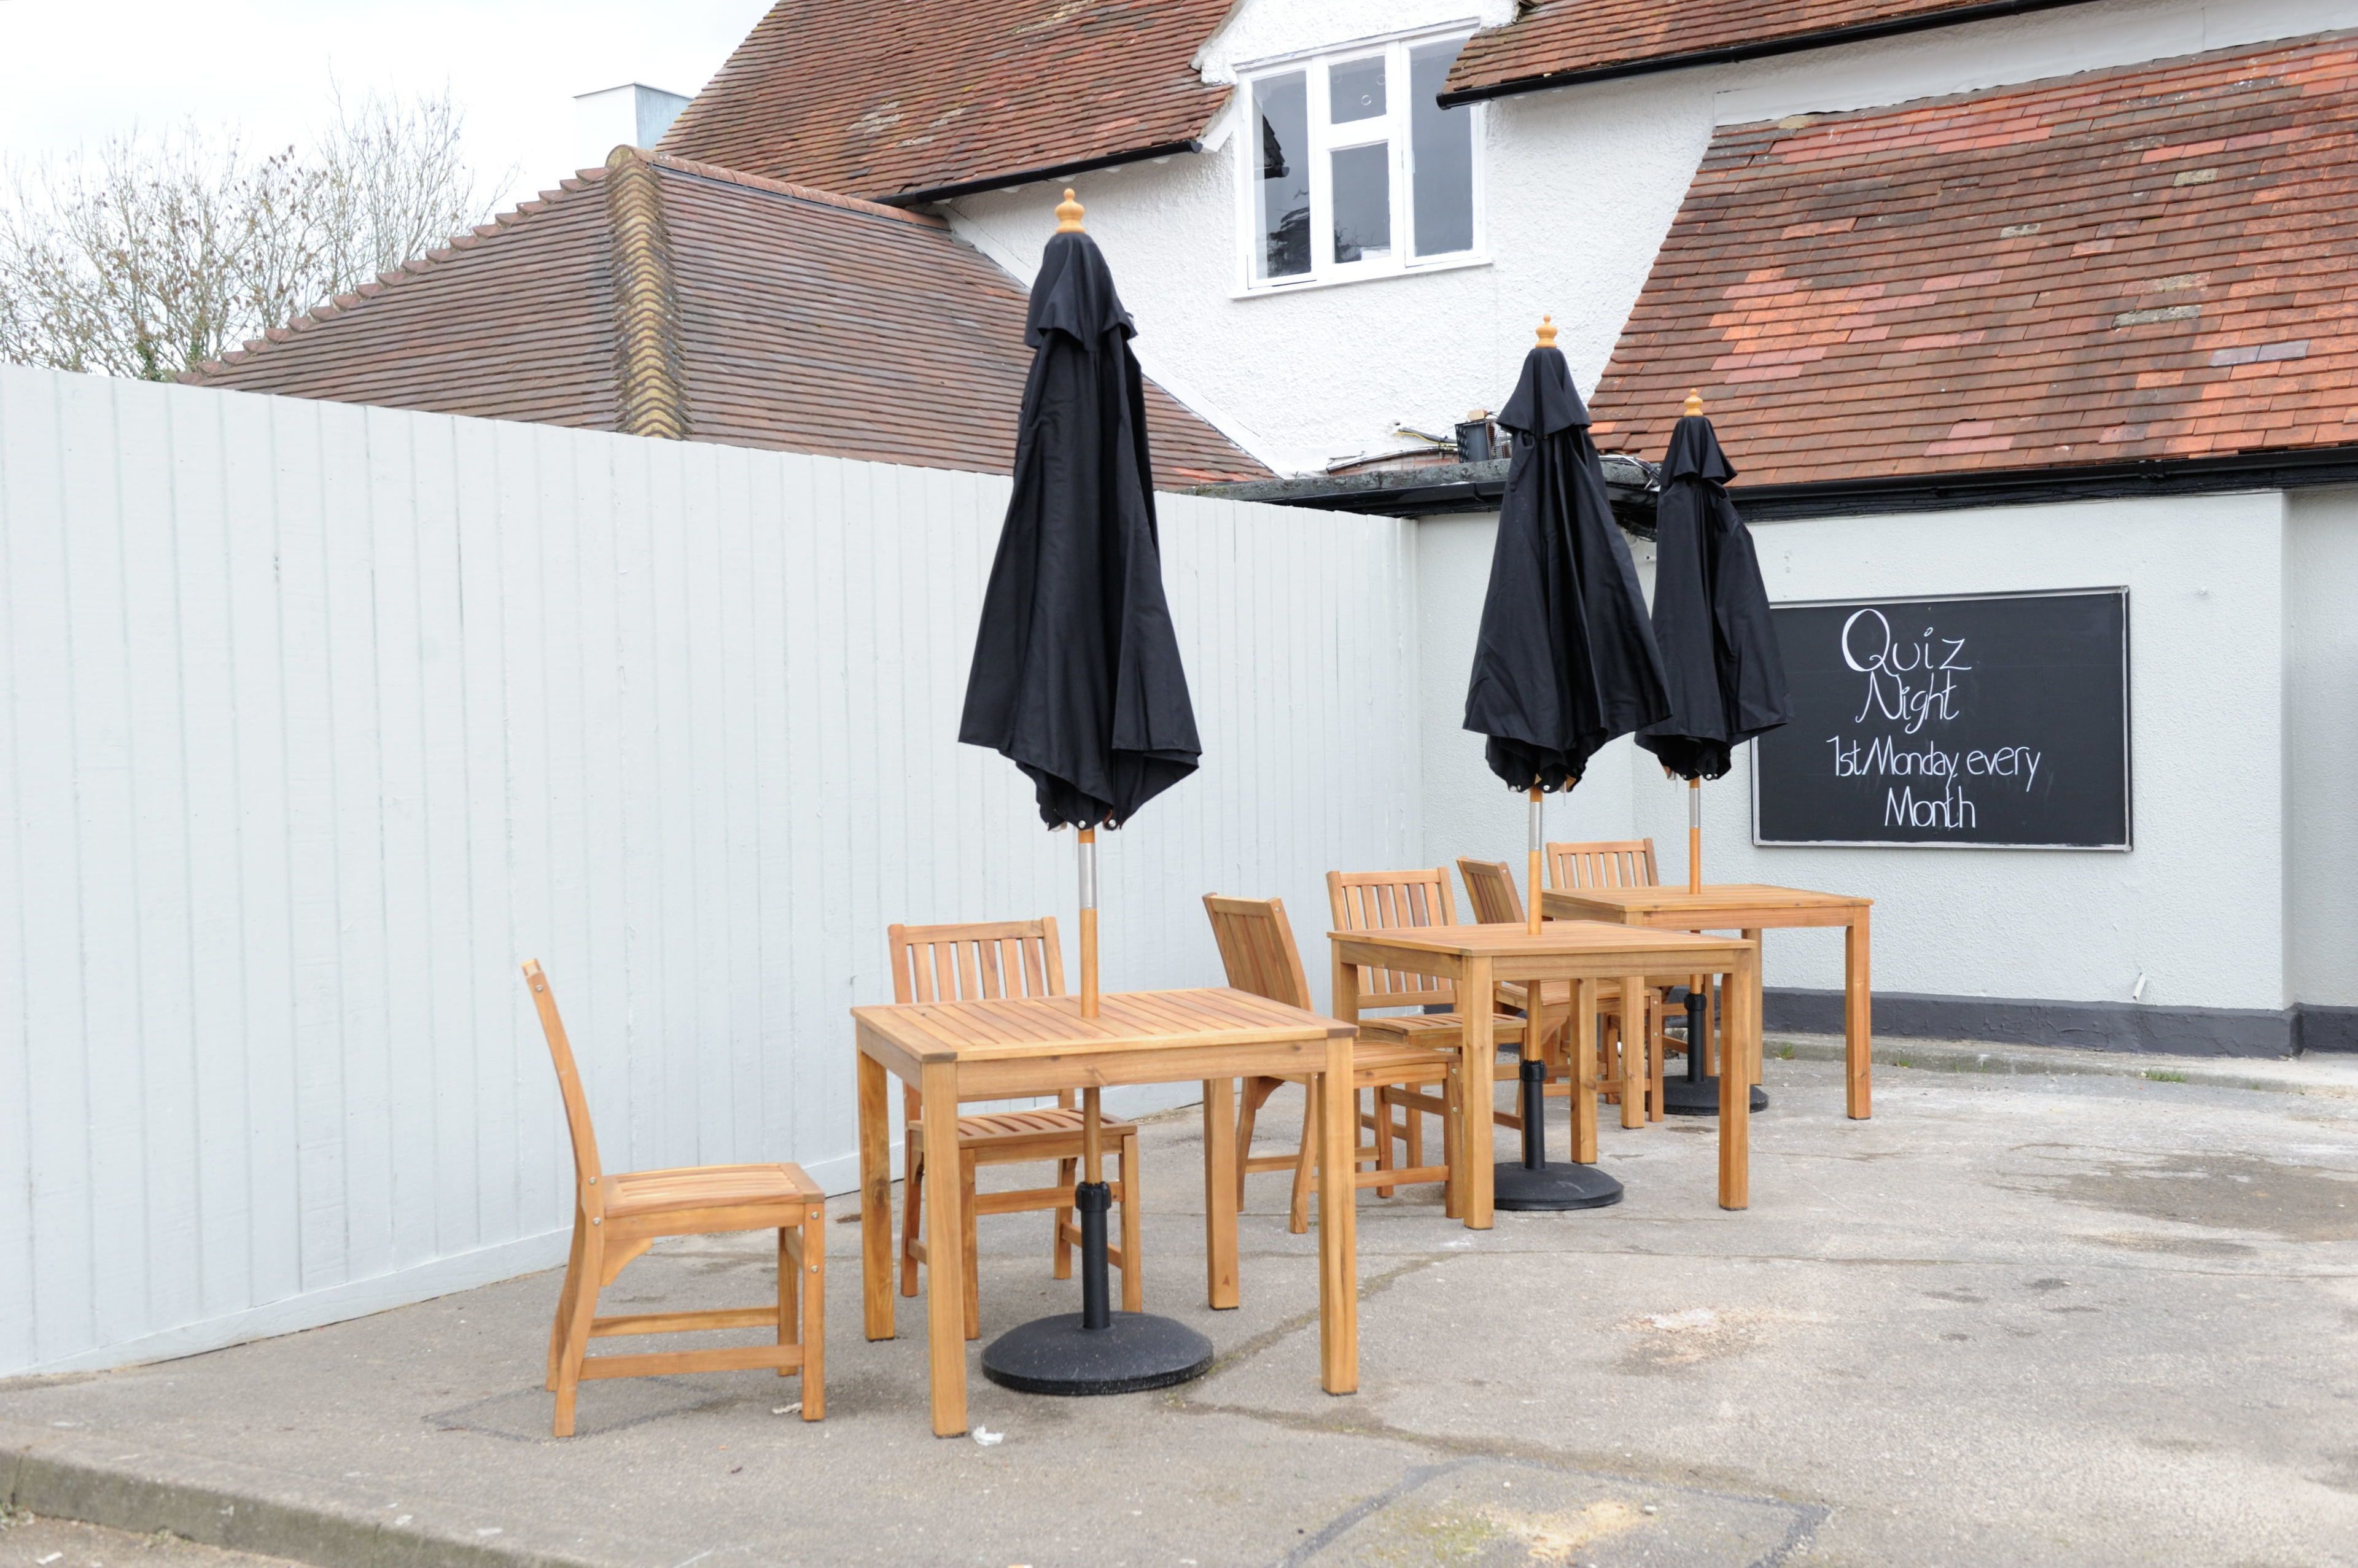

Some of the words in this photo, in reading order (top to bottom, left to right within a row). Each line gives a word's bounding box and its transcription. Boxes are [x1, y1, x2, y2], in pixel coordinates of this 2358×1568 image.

[1842, 608, 1972, 677] Quiz
[1855, 670, 1959, 734] Night
[1826, 735, 1862, 777] 1st
[1966, 746, 2041, 793] every
[1884, 785, 1976, 829] Month
